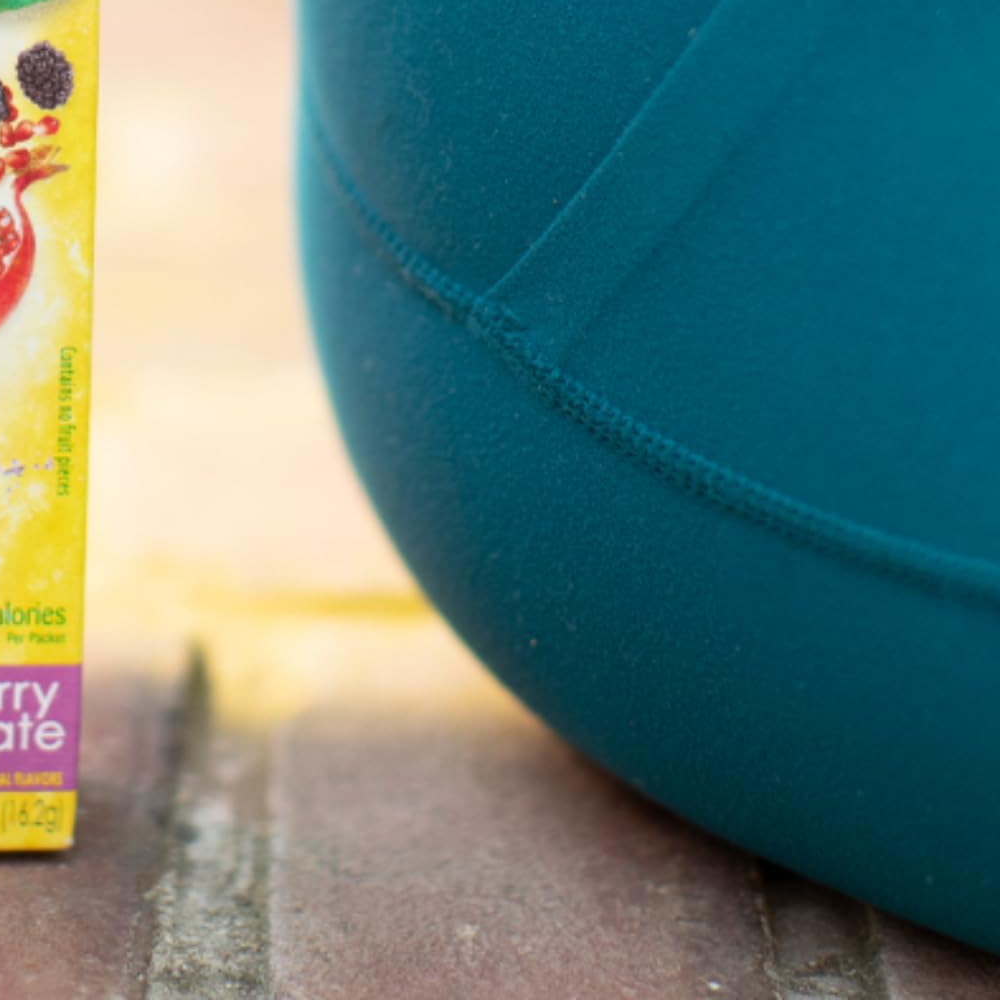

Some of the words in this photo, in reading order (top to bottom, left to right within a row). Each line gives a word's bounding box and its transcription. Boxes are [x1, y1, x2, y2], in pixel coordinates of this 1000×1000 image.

[58, 346, 77, 401] Contains
[58, 405, 73, 421] no
[57, 424, 77, 453] fruit
[54, 457, 72, 497] pieces
[1, 798, 66, 833] (16.2g)
